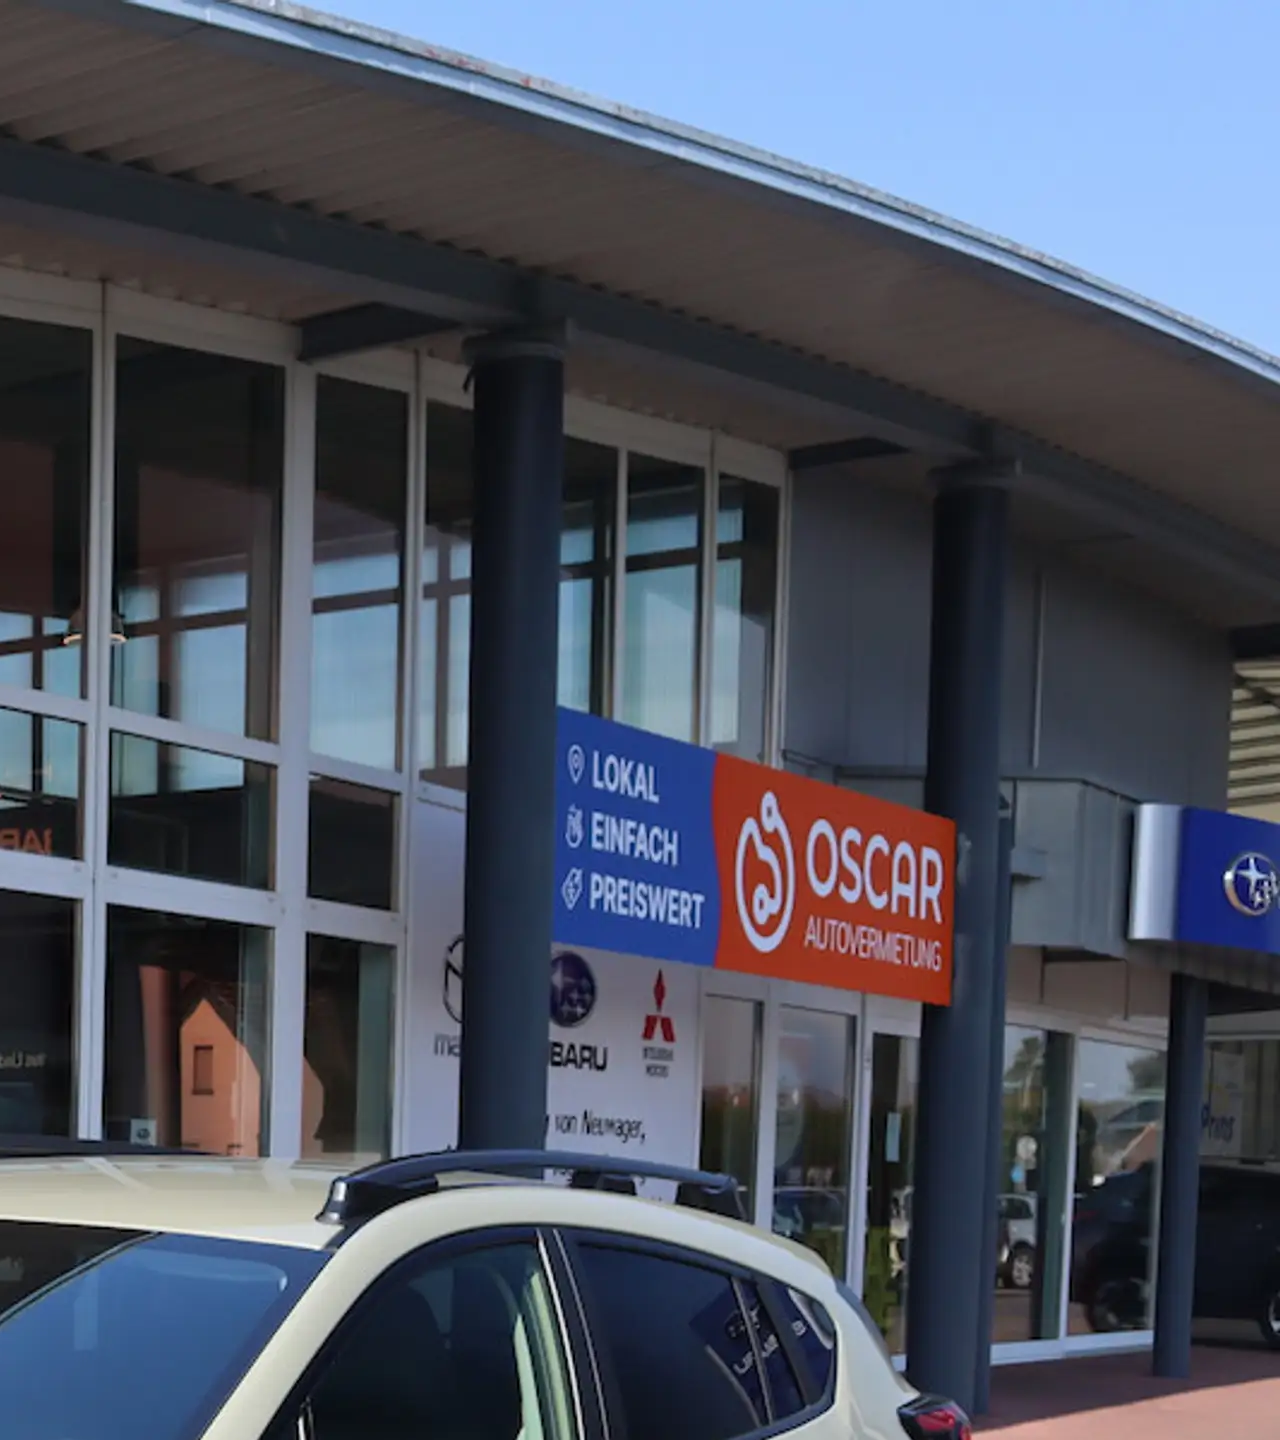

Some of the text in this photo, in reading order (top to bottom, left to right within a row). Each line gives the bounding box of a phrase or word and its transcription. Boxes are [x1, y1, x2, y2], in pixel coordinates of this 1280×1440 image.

[592, 751, 659, 803] LOKAL
[591, 816, 678, 866] EINFACH
[806, 818, 943, 924] OSCAR
[589, 874, 704, 929] PREISWERT
[803, 916, 942, 972] AUTOVERMIETUNG
[549, 1041, 608, 1071] BARU
